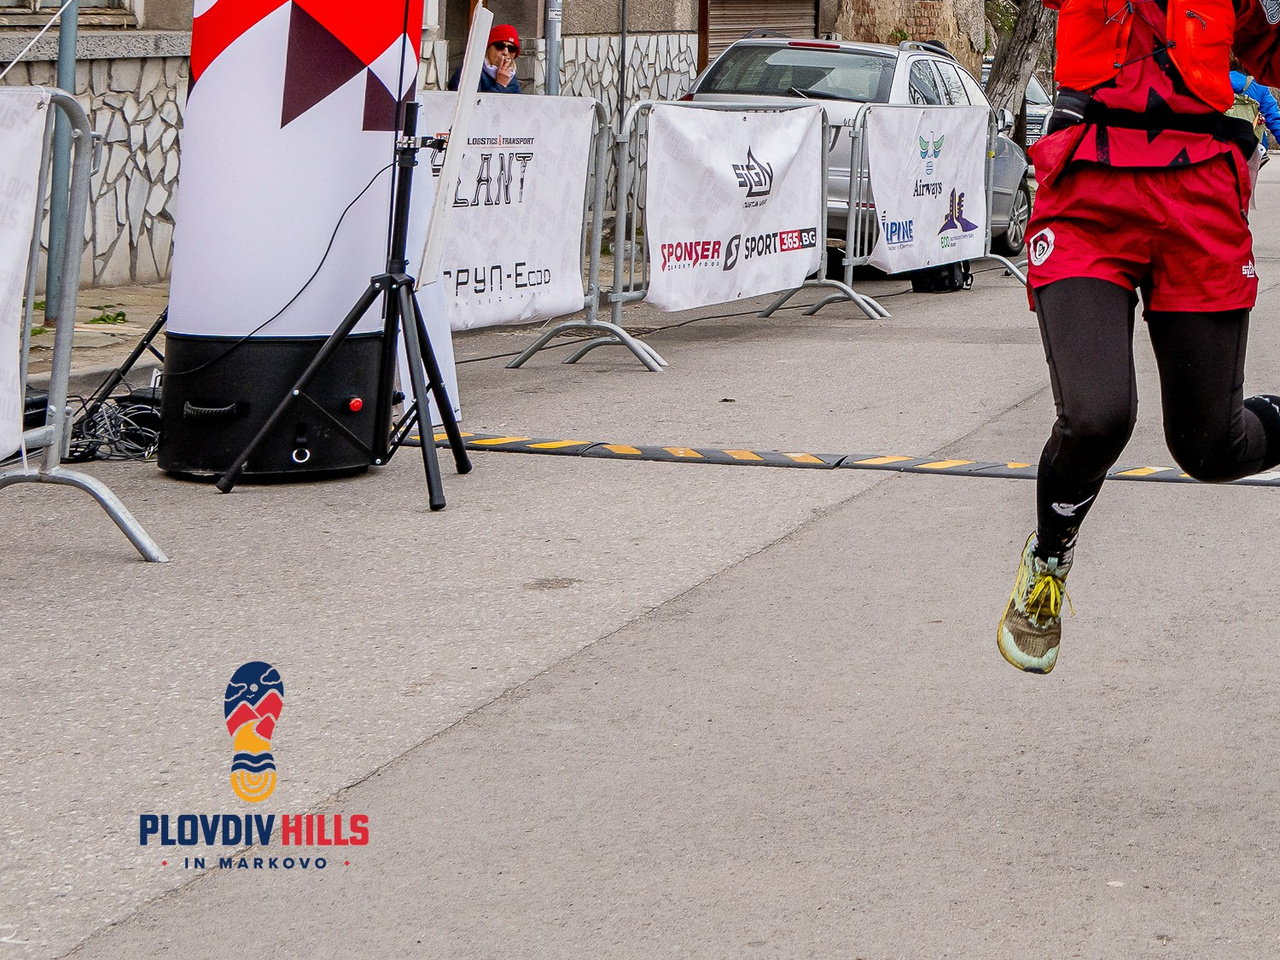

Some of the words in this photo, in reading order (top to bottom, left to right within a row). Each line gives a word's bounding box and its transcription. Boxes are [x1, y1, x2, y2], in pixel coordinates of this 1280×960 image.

[502, 137, 535, 146] TRANSPORT
[912, 179, 943, 199] Airways
[661, 240, 721, 272] SPONSER
